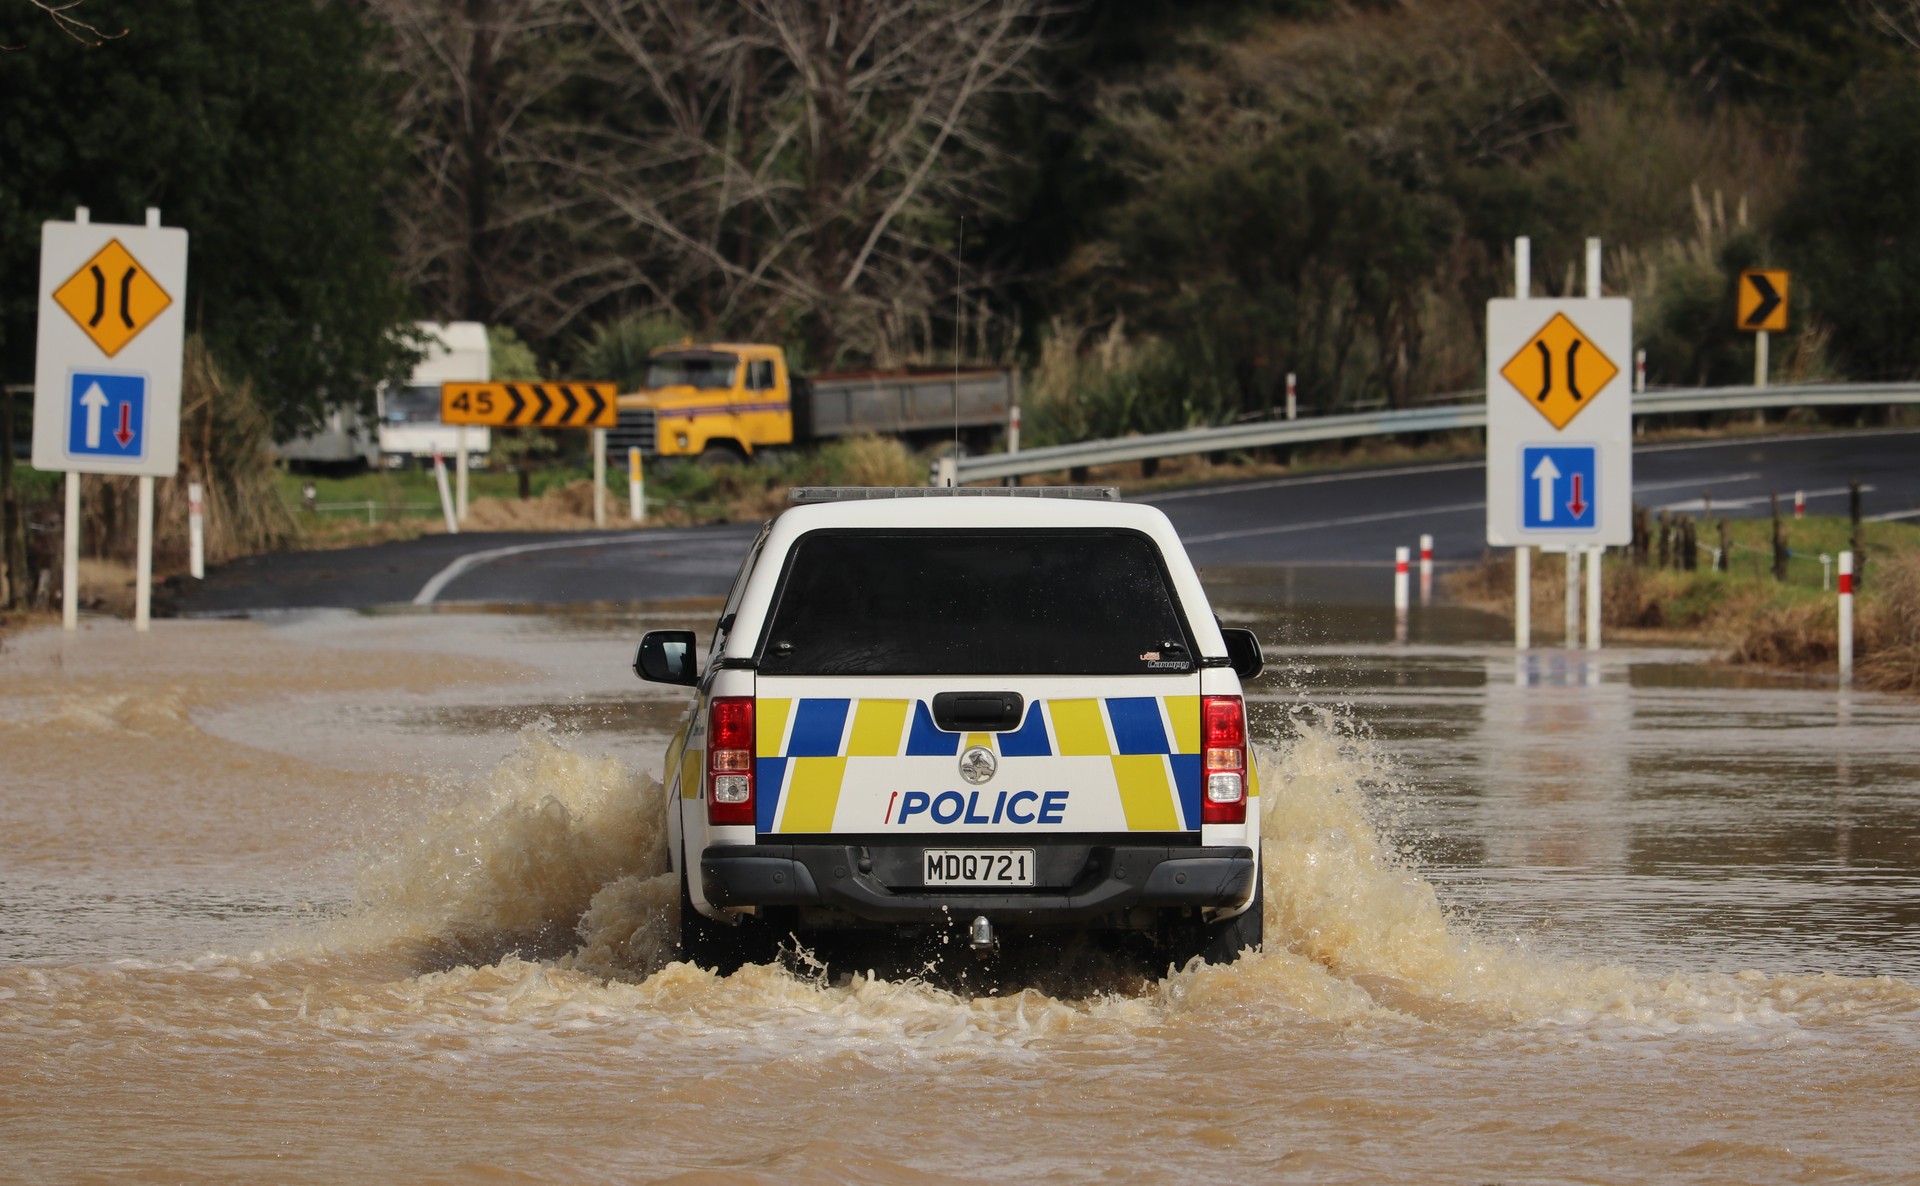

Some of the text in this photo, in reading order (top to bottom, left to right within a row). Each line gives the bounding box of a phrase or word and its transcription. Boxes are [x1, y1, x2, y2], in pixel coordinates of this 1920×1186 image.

[451, 391, 494, 415] 45
[897, 790, 1070, 825] POLICE
[927, 854, 1027, 881] MDQ721
